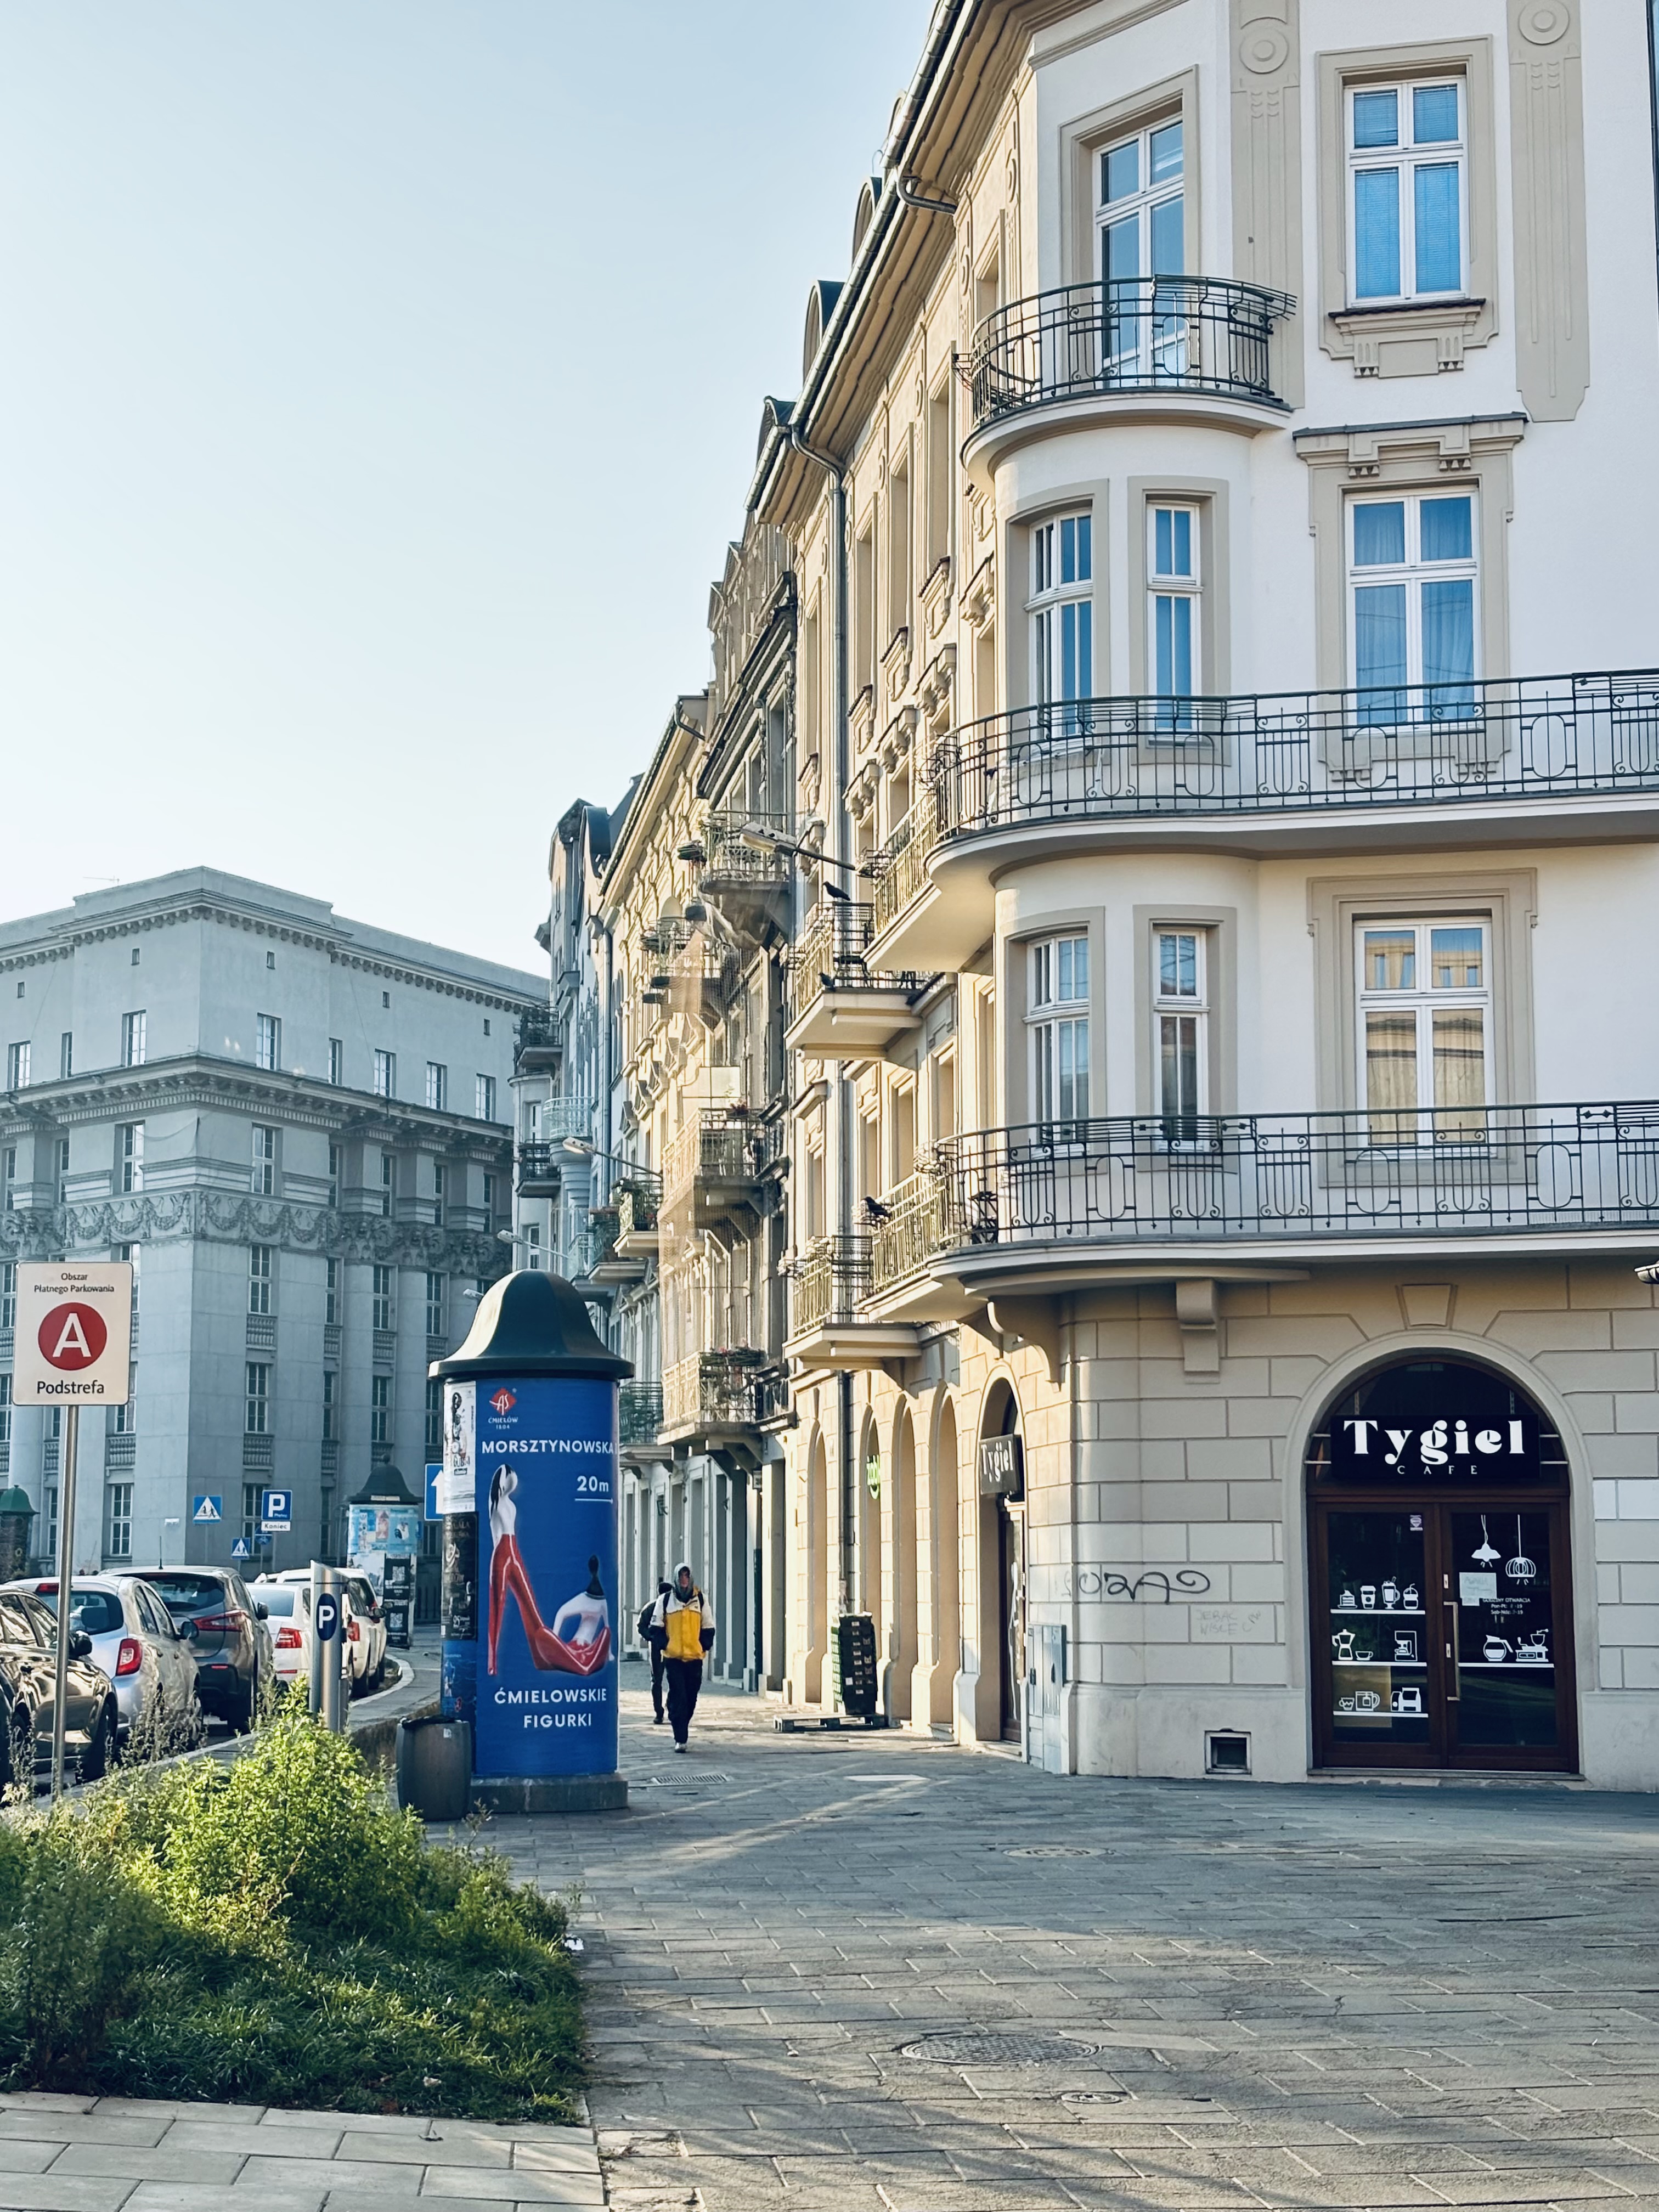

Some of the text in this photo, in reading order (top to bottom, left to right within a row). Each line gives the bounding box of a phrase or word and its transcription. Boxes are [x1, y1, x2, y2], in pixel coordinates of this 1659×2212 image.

[61, 1272, 88, 1280] Obszar
[34, 1284, 115, 1295] Płatnego Parkowania
[52, 1313, 92, 1357] A
[37, 1380, 105, 1394] Podstrefa
[482, 1439, 614, 1454] MORSZTYNOWSKA
[1343, 1420, 1525, 1465] Tygiel
[980, 1440, 1013, 1482] Tygiel
[866, 1454, 880, 1486] żab
[1397, 1465, 1477, 1475] CAFE
[576, 1475, 610, 1492] 20m
[268, 1494, 285, 1517] P
[319, 1605, 335, 1629] P
[494, 1687, 607, 1704] ĆMIELOWSKIE
[523, 1713, 592, 1728] FIGURKI
